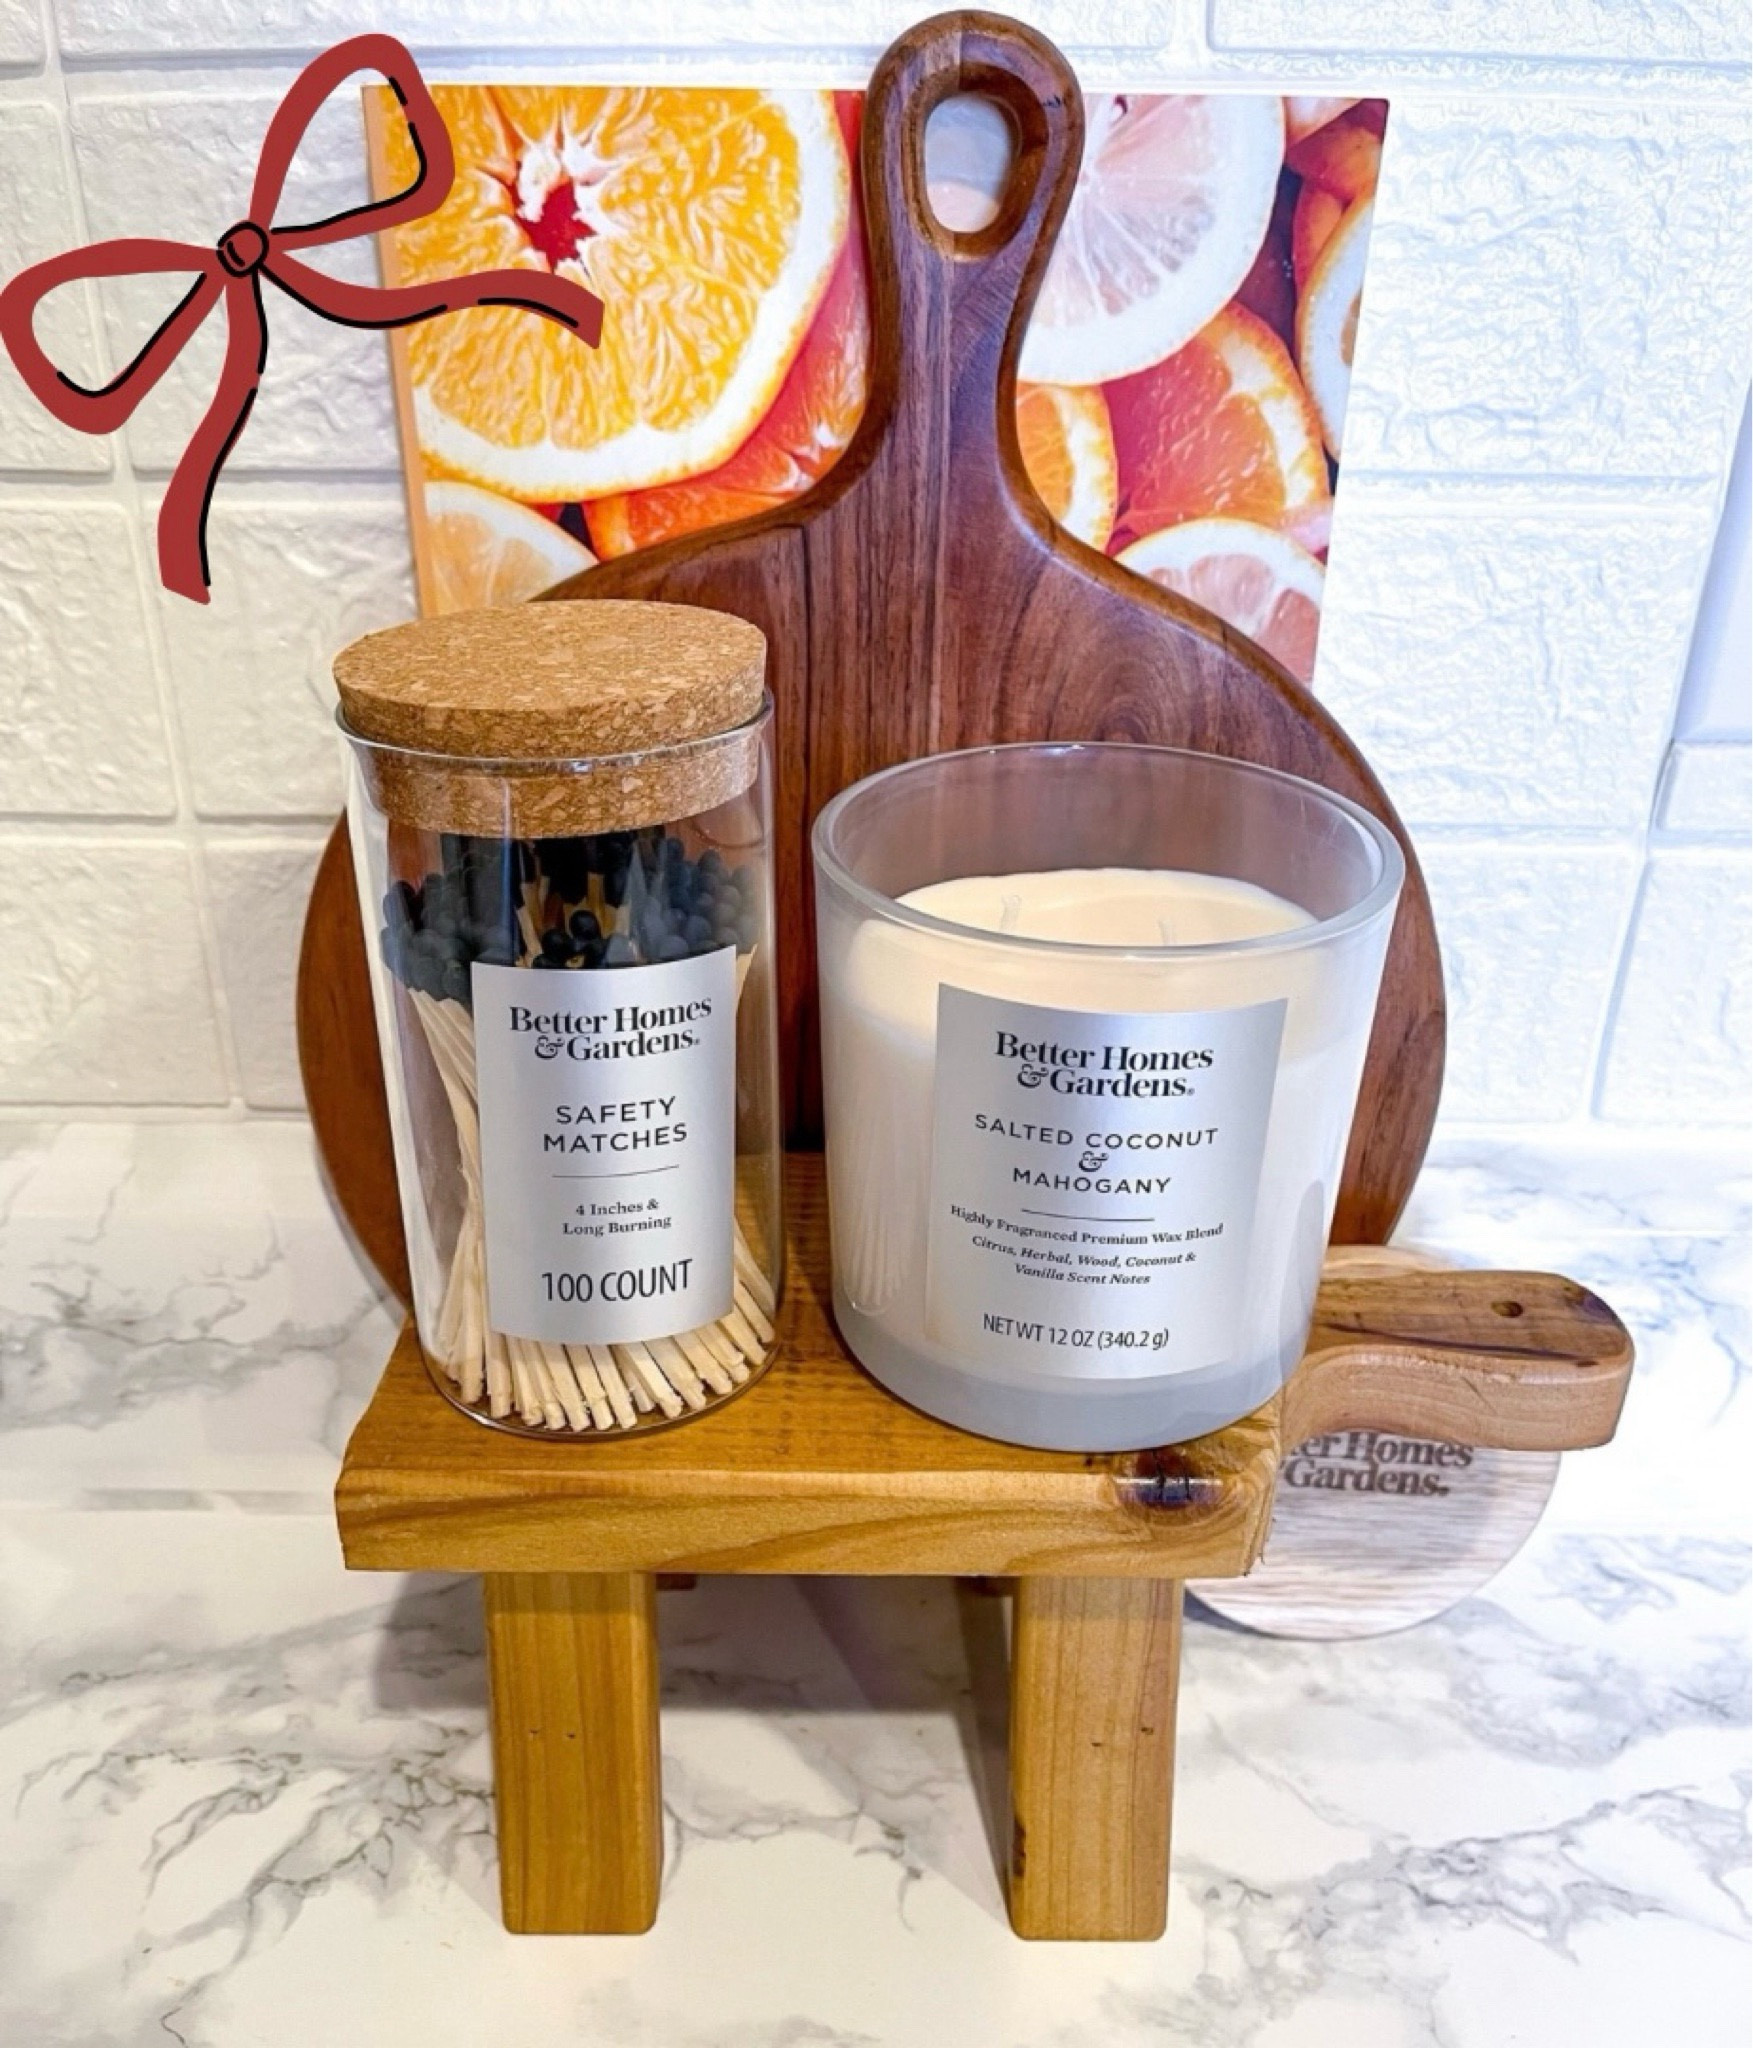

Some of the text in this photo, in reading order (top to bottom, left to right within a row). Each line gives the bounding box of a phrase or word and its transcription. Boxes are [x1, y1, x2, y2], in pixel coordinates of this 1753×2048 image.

[510, 997, 712, 1034] Better Homes
[995, 1030, 1214, 1072] Better Homes
[556, 1096, 676, 1125] SAFETY
[544, 1123, 688, 1153] MATCHES
[975, 1114, 1219, 1150] SALTED COCONUT
[1078, 1151, 1109, 1172] &
[1013, 1167, 1172, 1194] MAHOGANY
[576, 1198, 659, 1216] 4 Inches &
[562, 1216, 672, 1237] Long Burning
[951, 1204, 1224, 1245] Highly Fragranced Premium Wax Blend
[972, 1235, 1197, 1269] Citrus, Herbal, Wood, Coconut &
[542, 1258, 693, 1303] 100 COUNT
[1014, 1263, 1151, 1285] Vanilla Scent Notes
[983, 1312, 1169, 1351] NET WT 12 OZ (340.2 g)
[1342, 1431, 1475, 1468] Homes
